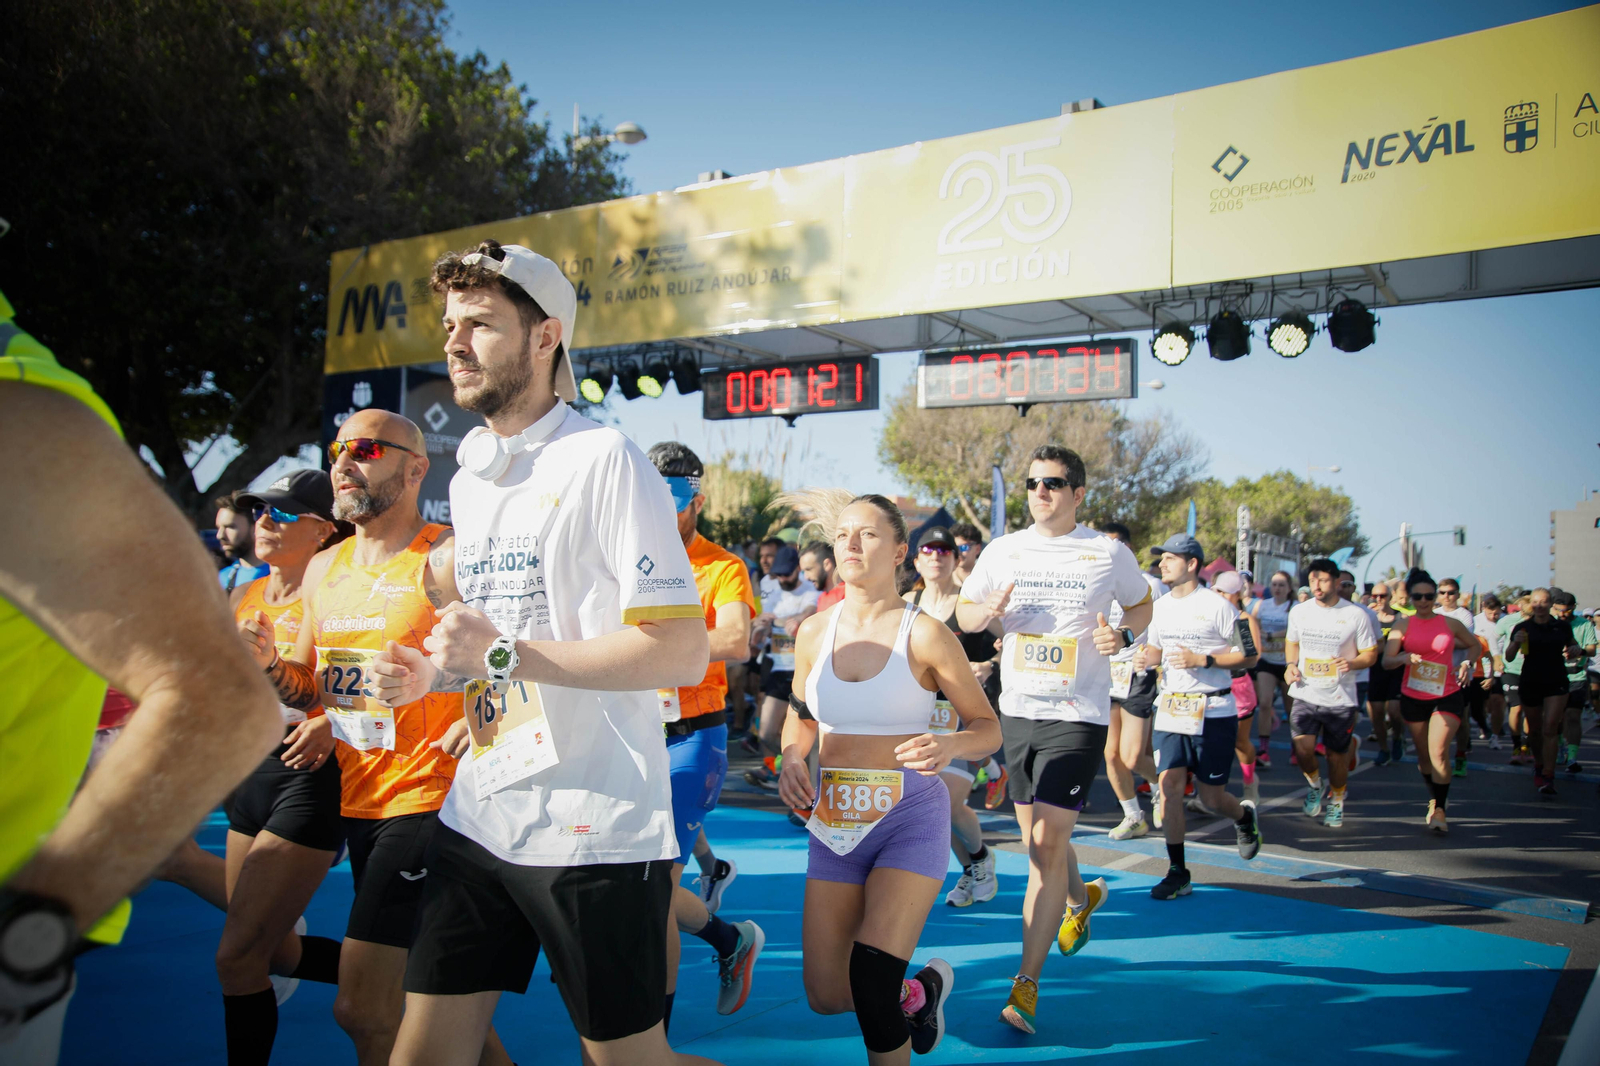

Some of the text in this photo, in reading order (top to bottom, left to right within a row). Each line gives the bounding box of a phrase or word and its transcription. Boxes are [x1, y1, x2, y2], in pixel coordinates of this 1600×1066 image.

[1350, 171, 1376, 183] 2020
[937, 135, 1074, 256] 25
[1209, 174, 1314, 201] COOPERACIÓN
[1209, 198, 1244, 214] 2005
[933, 246, 1071, 289] EDICIÓN
[605, 283, 661, 305] RAMÓN
[666, 278, 705, 297] RUIZ
[711, 266, 792, 291] ANDÚJAR
[498, 551, 540, 572] 2024
[637, 577, 685, 587] COOPERACIÓN
[637, 586, 656, 594] 2005
[1013, 579, 1087, 590] Almería 2024
[1024, 643, 1063, 664] 980
[1308, 663, 1330, 673] 433
[1416, 665, 1441, 680] 432
[825, 784, 893, 812] 1386
[842, 812, 861, 820] GILA
